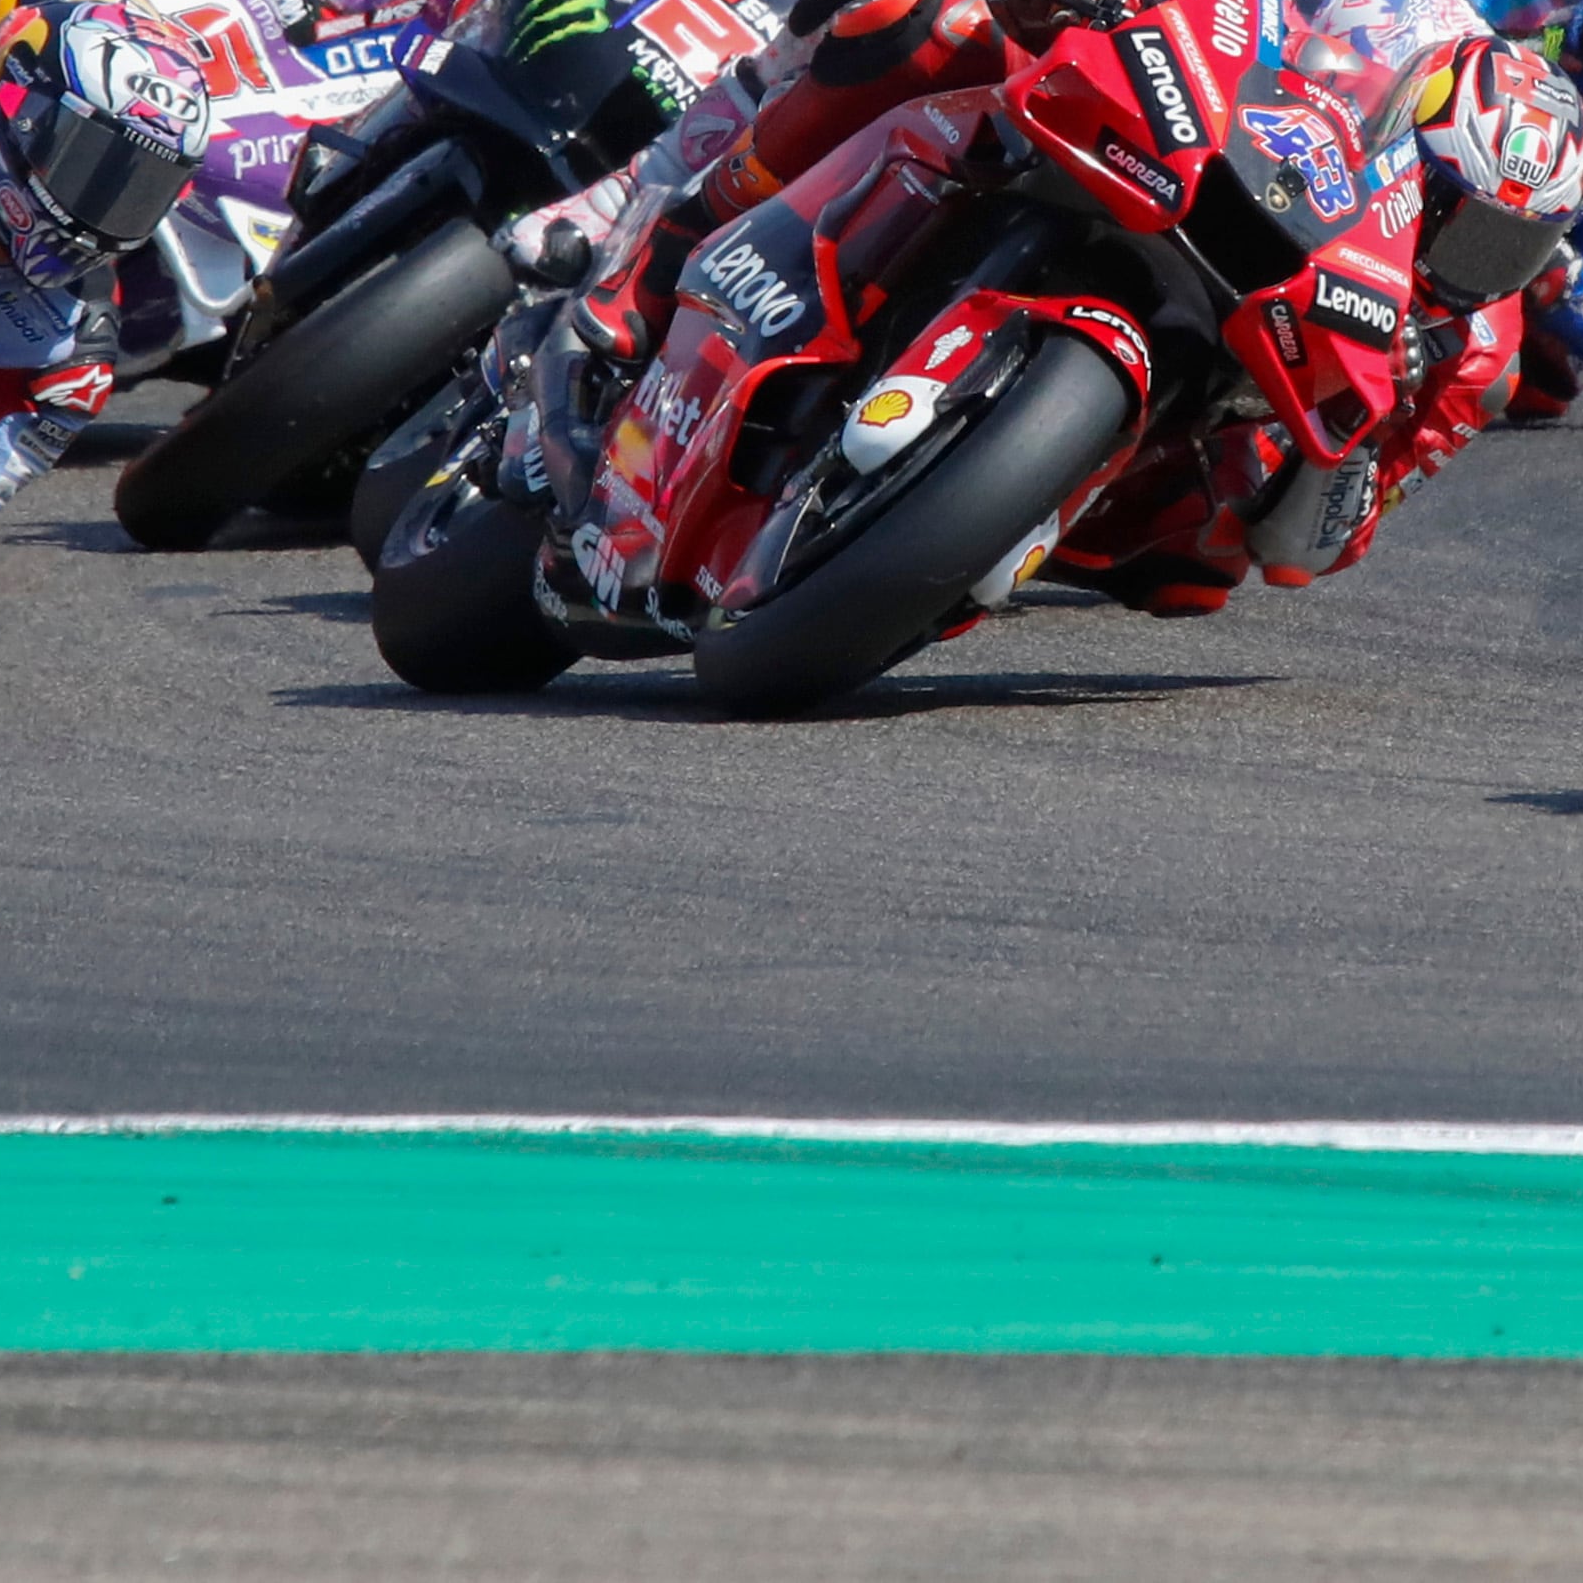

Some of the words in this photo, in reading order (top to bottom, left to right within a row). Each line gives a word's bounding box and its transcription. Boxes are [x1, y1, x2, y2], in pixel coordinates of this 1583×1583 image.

[324, 35, 397, 74] OCT
[1130, 30, 1199, 145] Lenovo
[1303, 80, 1362, 153] VARGROUP
[1104, 142, 1178, 203] CARRERA
[1237, 104, 1360, 223] 43
[1506, 157, 1542, 181] agv
[698, 220, 807, 339] Lenovo
[1338, 247, 1411, 289] FRECCIAROSSA
[1270, 304, 1300, 363] CARRERA
[1316, 273, 1397, 334] Lenovo
[693, 564, 723, 601] SKF
